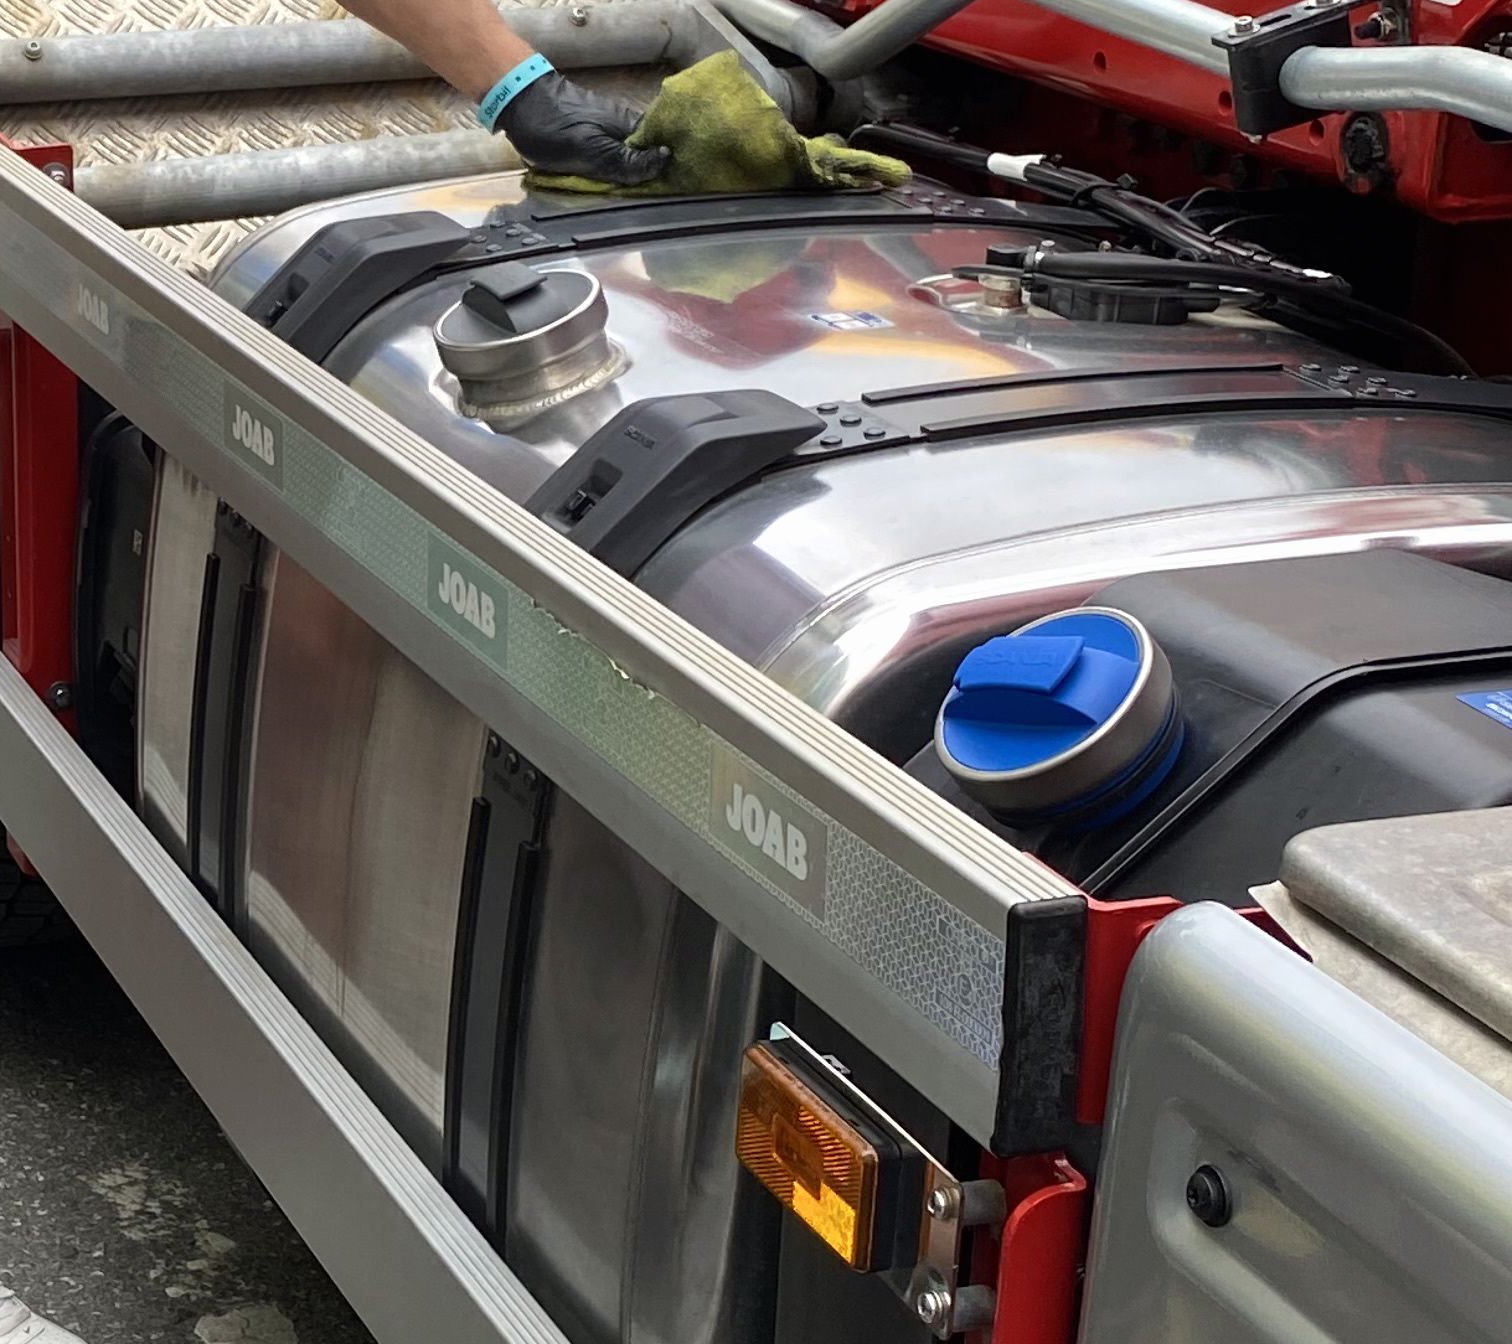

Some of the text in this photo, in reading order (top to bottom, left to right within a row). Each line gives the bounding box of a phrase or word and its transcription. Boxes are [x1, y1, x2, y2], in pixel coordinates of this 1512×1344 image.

[232, 404, 275, 466] JOAB
[438, 562, 496, 640] JOAB
[725, 783, 808, 881] JOAB
